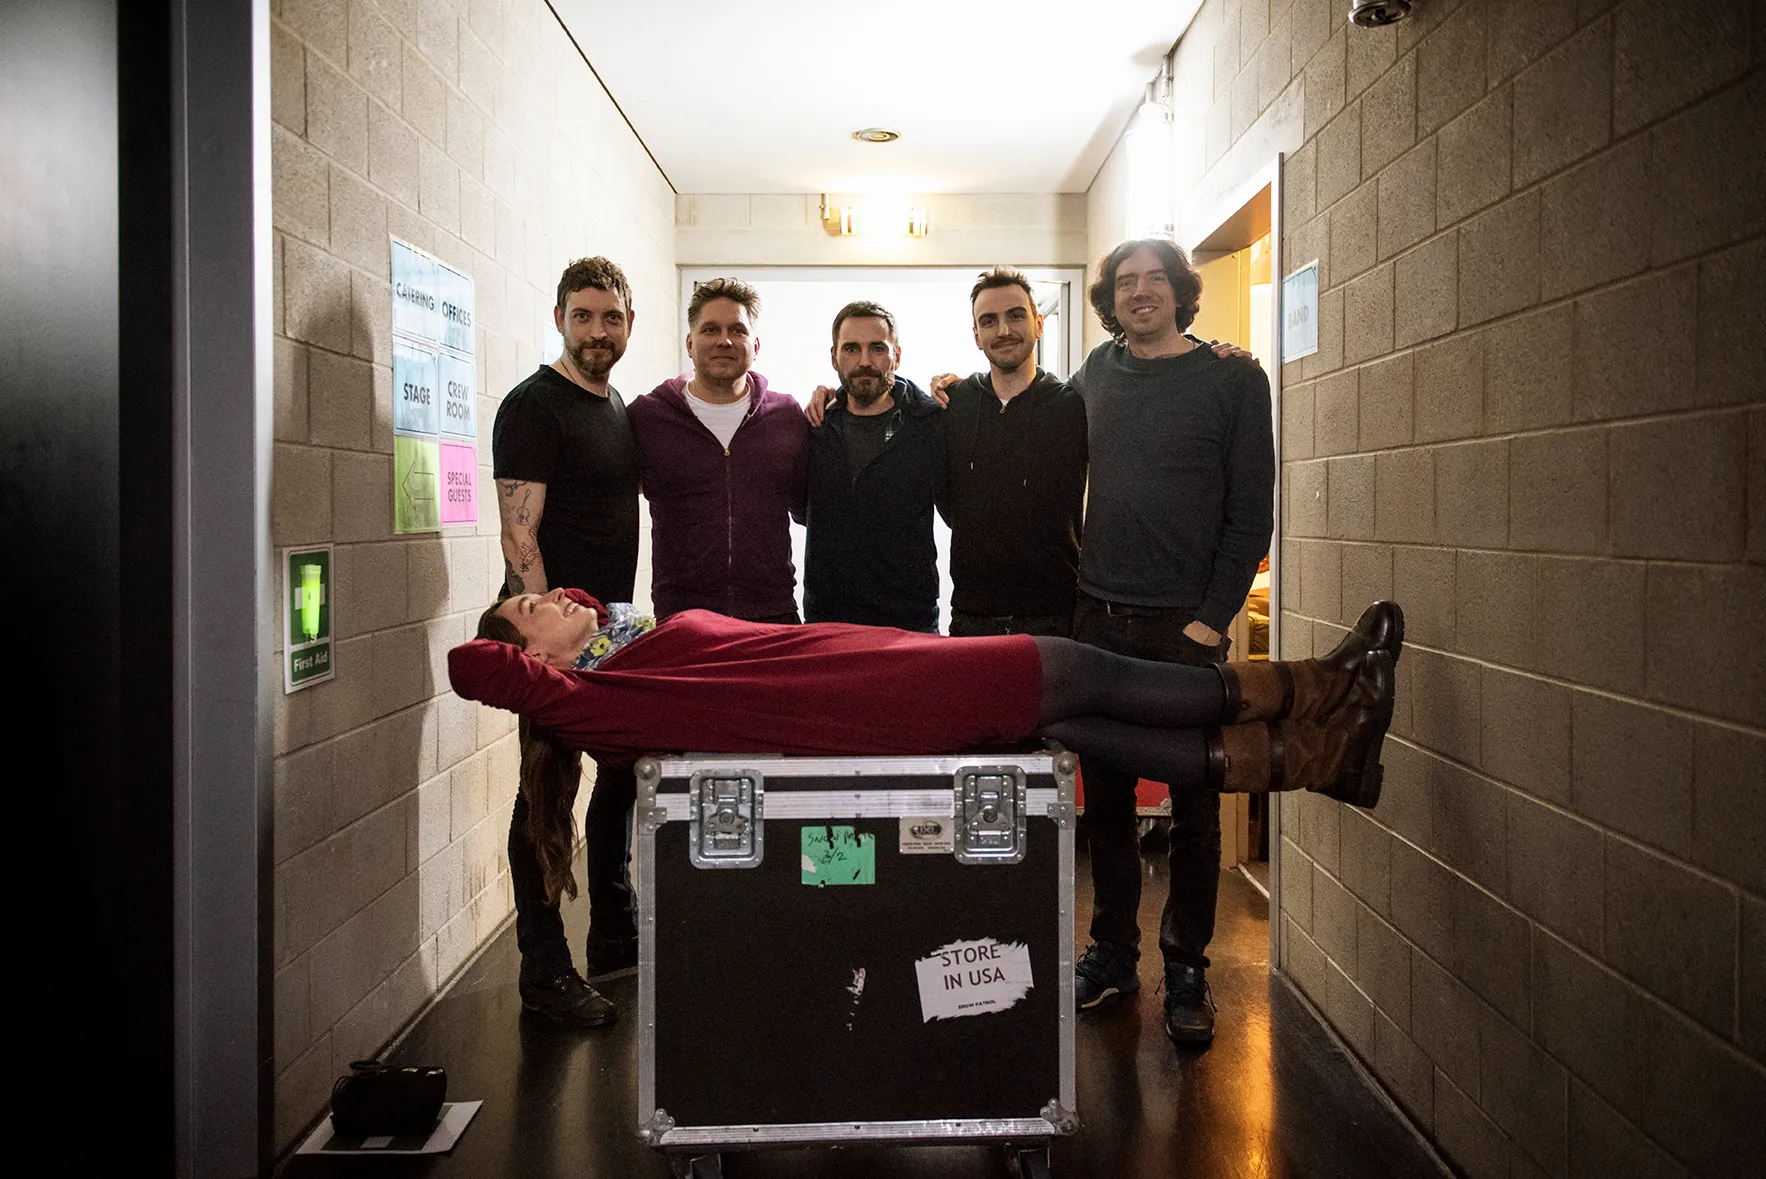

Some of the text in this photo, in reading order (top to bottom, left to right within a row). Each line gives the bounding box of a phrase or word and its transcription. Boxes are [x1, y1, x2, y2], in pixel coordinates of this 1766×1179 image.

[396, 282, 435, 311] CATERING
[441, 301, 472, 327] OFFICES
[1287, 304, 1309, 329] BAND
[403, 382, 431, 405] STAGE
[447, 380, 469, 401] CREW
[446, 401, 471, 421] ROOM
[447, 471, 472, 487] SPECIAL
[447, 488, 472, 503] GUESTS
[293, 650, 328, 672] First Aid
[940, 944, 1002, 967] STORE
[943, 966, 1006, 990] IN USA
